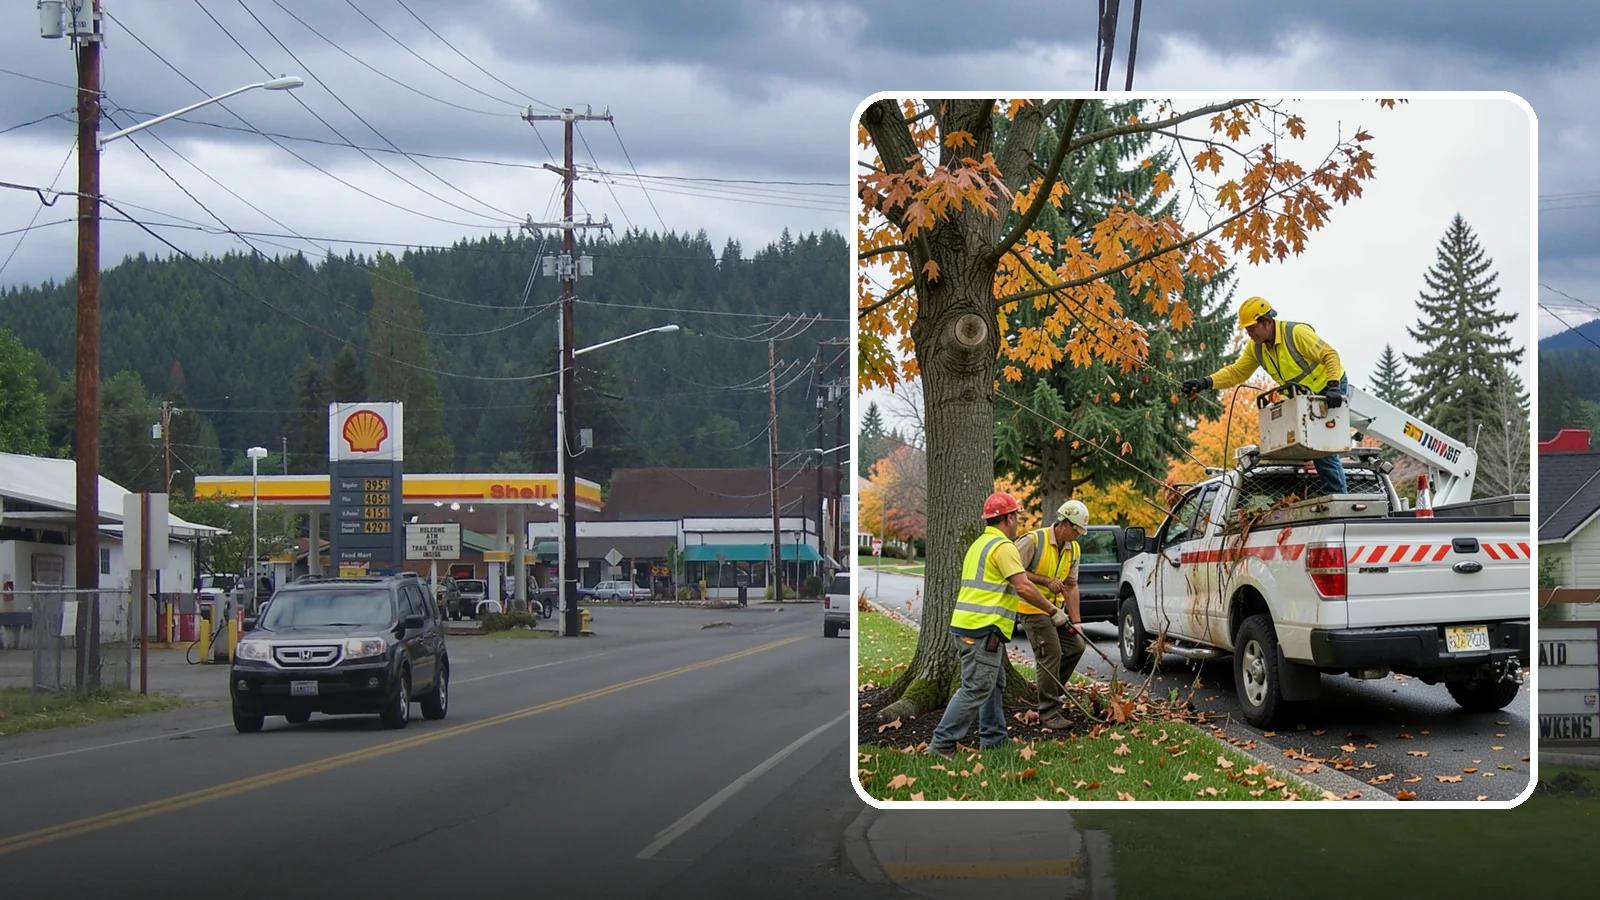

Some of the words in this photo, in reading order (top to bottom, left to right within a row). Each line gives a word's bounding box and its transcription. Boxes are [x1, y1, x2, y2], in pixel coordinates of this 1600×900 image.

[366, 480, 383, 490] 395
[490, 484, 547, 499] Shell
[366, 494, 383, 504] 405
[366, 508, 383, 518] 415
[366, 522, 383, 532] 429
[1539, 643, 1567, 665] AID
